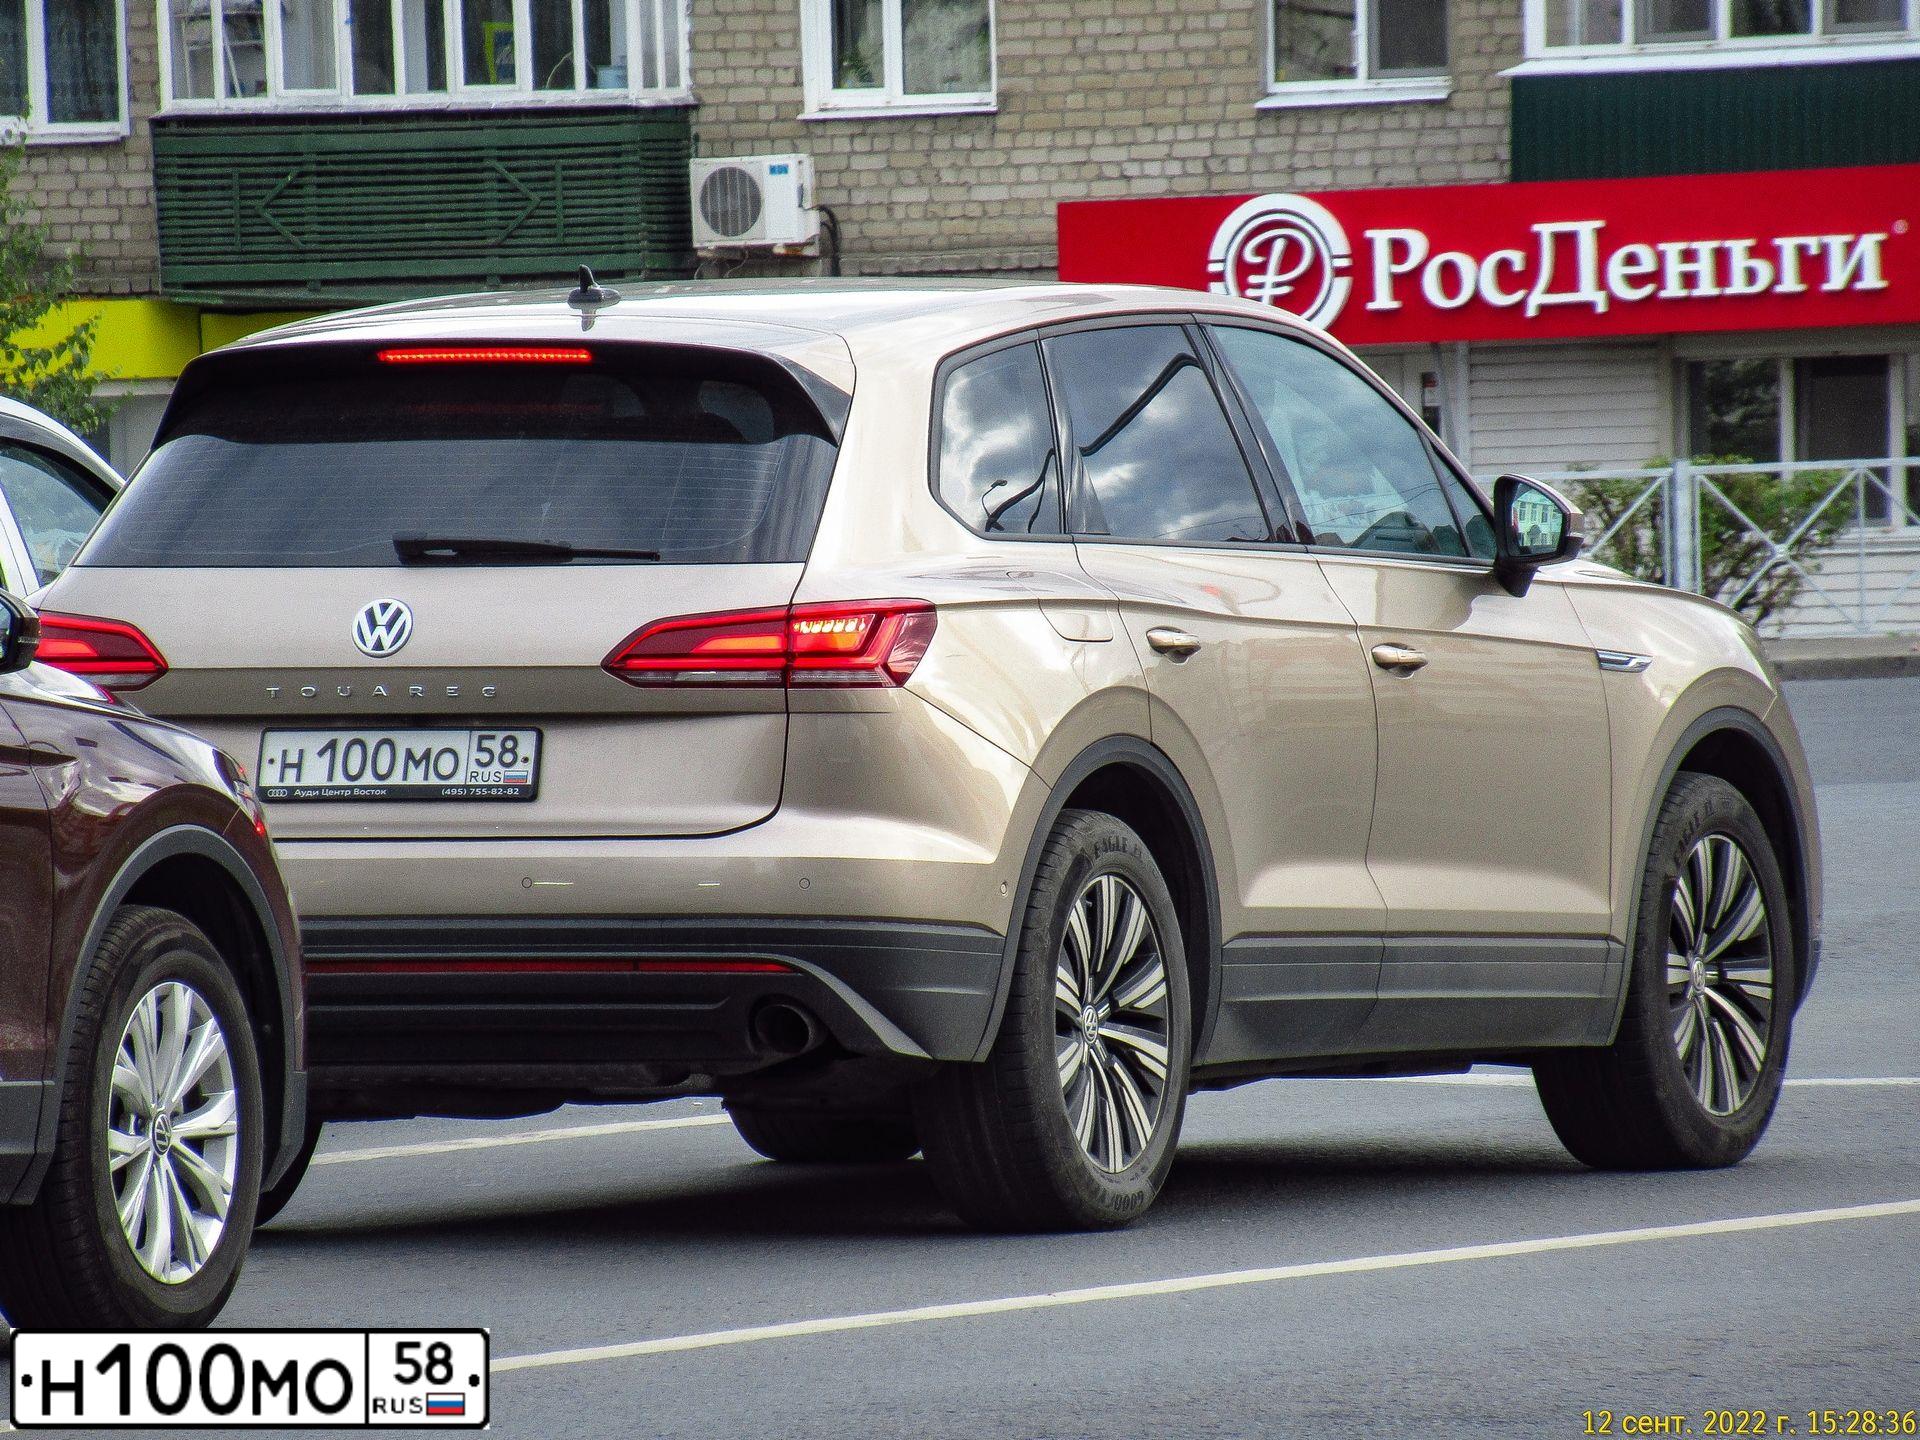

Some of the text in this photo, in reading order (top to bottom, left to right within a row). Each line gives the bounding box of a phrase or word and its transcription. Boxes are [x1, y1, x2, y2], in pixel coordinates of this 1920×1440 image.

[1365, 219, 1889, 317] РосДеньги
[266, 686, 497, 698] TOUAREG
[475, 734, 518, 768] 58
[469, 771, 502, 783] RUS
[294, 788, 387, 798] Ауди Центр Восток
[441, 788, 519, 796] (495) 755-82-82
